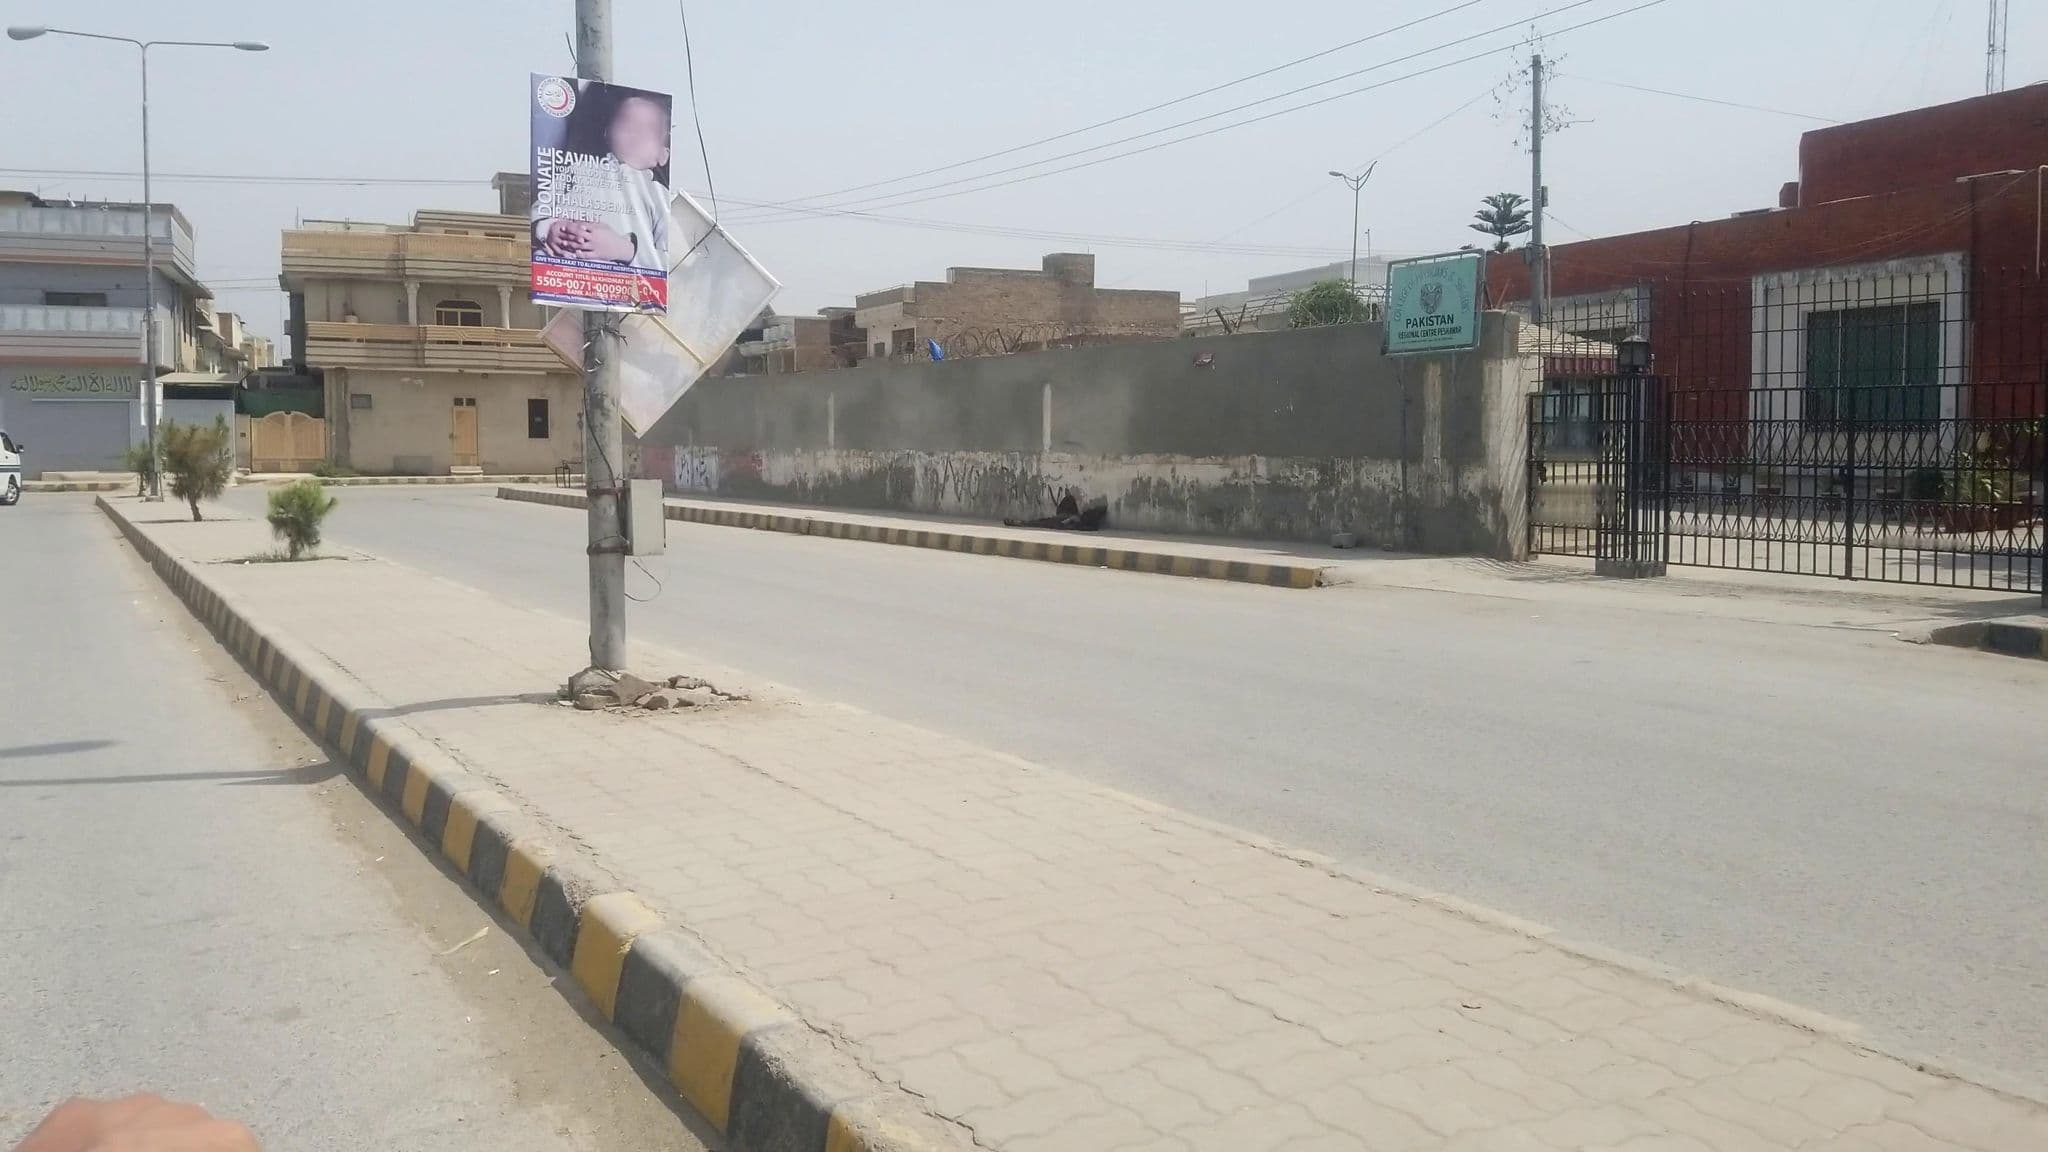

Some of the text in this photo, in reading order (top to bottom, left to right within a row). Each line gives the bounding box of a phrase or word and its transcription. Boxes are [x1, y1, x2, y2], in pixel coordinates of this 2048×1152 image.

[555, 165, 570, 175] YOU
[537, 146, 553, 217] DONATE
[555, 206, 601, 223] PATIENT
[545, 270, 573, 279] ACCOUNT
[1406, 314, 1454, 328] PAKISTAN
[1420, 329, 1437, 338] CENTRE
